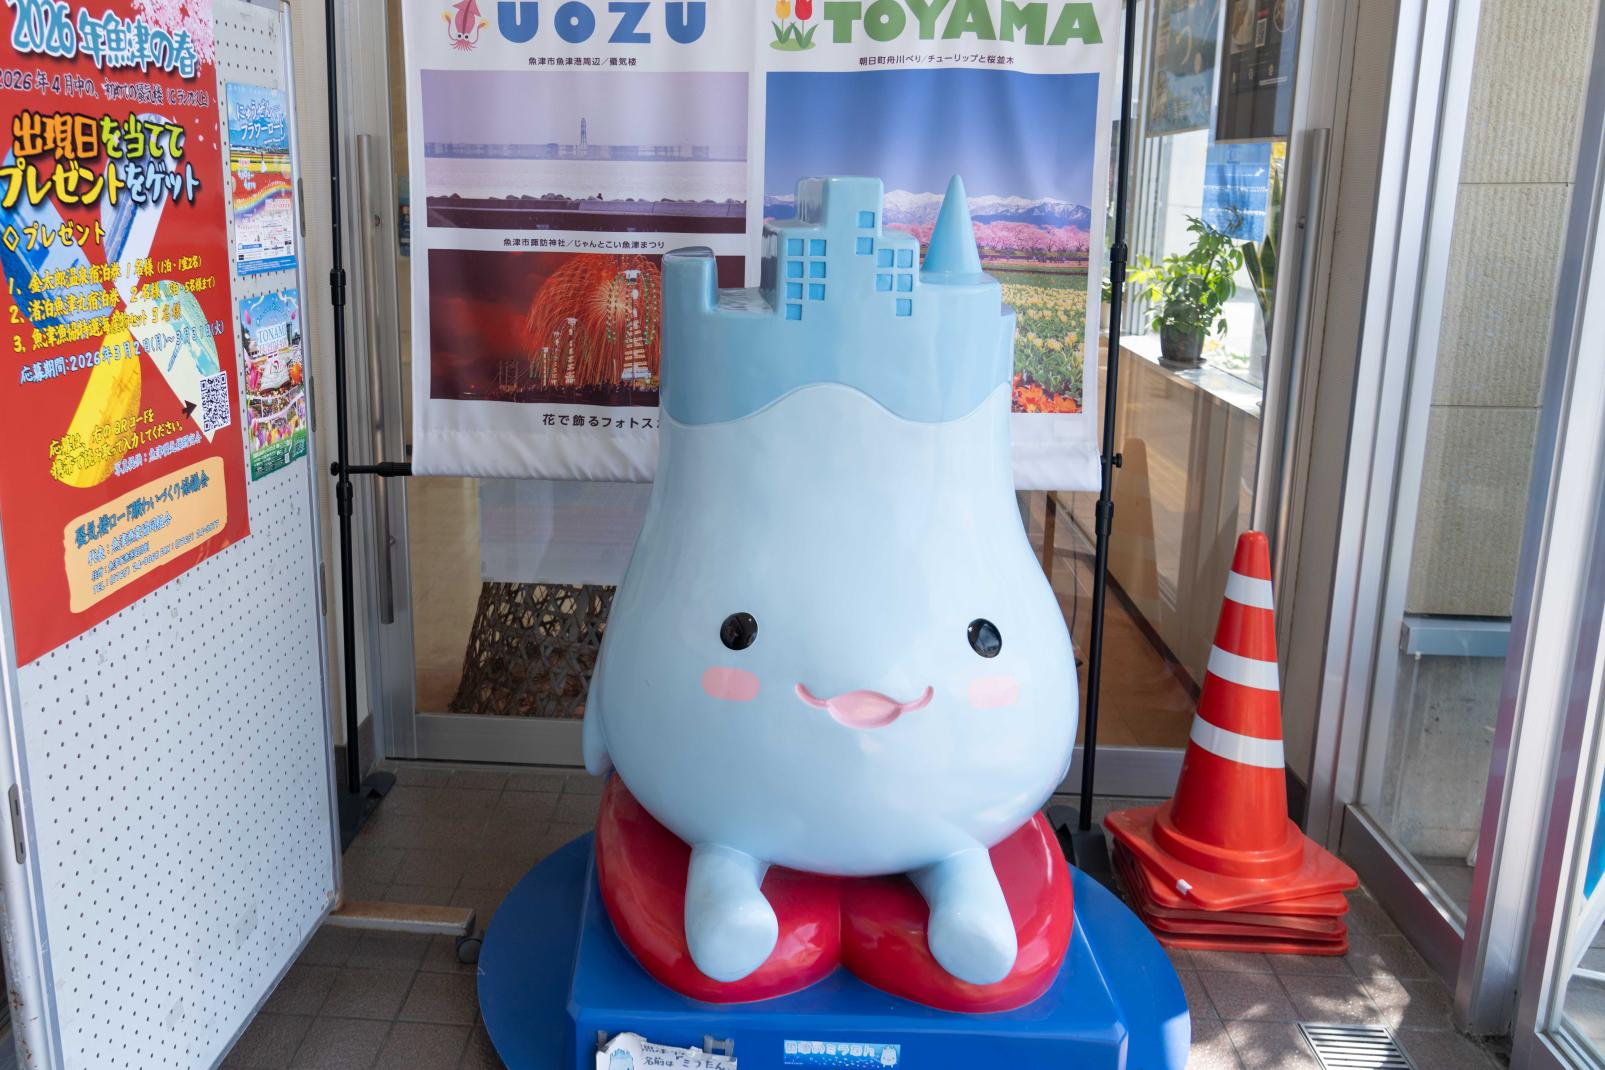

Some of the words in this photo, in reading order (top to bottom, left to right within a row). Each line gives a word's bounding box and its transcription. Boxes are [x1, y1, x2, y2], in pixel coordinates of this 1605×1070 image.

[497, 0, 706, 44] UOZU
[823, 0, 1103, 46] TOYAMA
[12, 110, 185, 160] 出現日を当てて
[0, 160, 200, 208] プレゼントをゲット
[23, 220, 105, 251] プレゼント
[542, 413, 659, 429] 花で飾るフォトス
